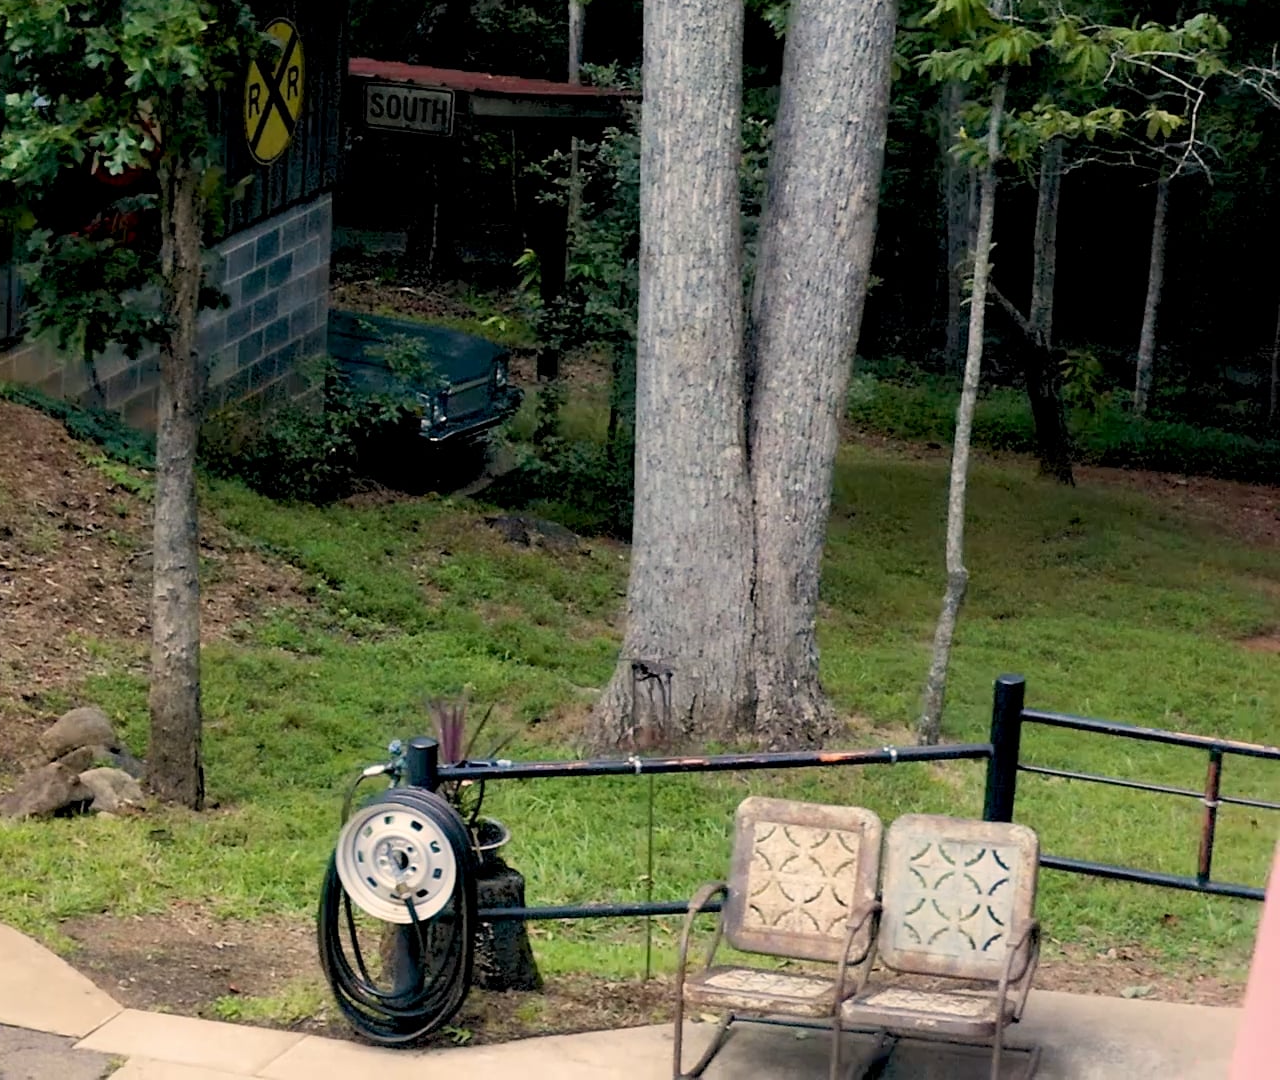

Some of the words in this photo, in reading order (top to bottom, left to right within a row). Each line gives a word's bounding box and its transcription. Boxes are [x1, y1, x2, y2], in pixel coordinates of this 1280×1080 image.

[288, 65, 299, 100] R
[248, 82, 261, 119] R
[370, 92, 448, 125] SOUTH
